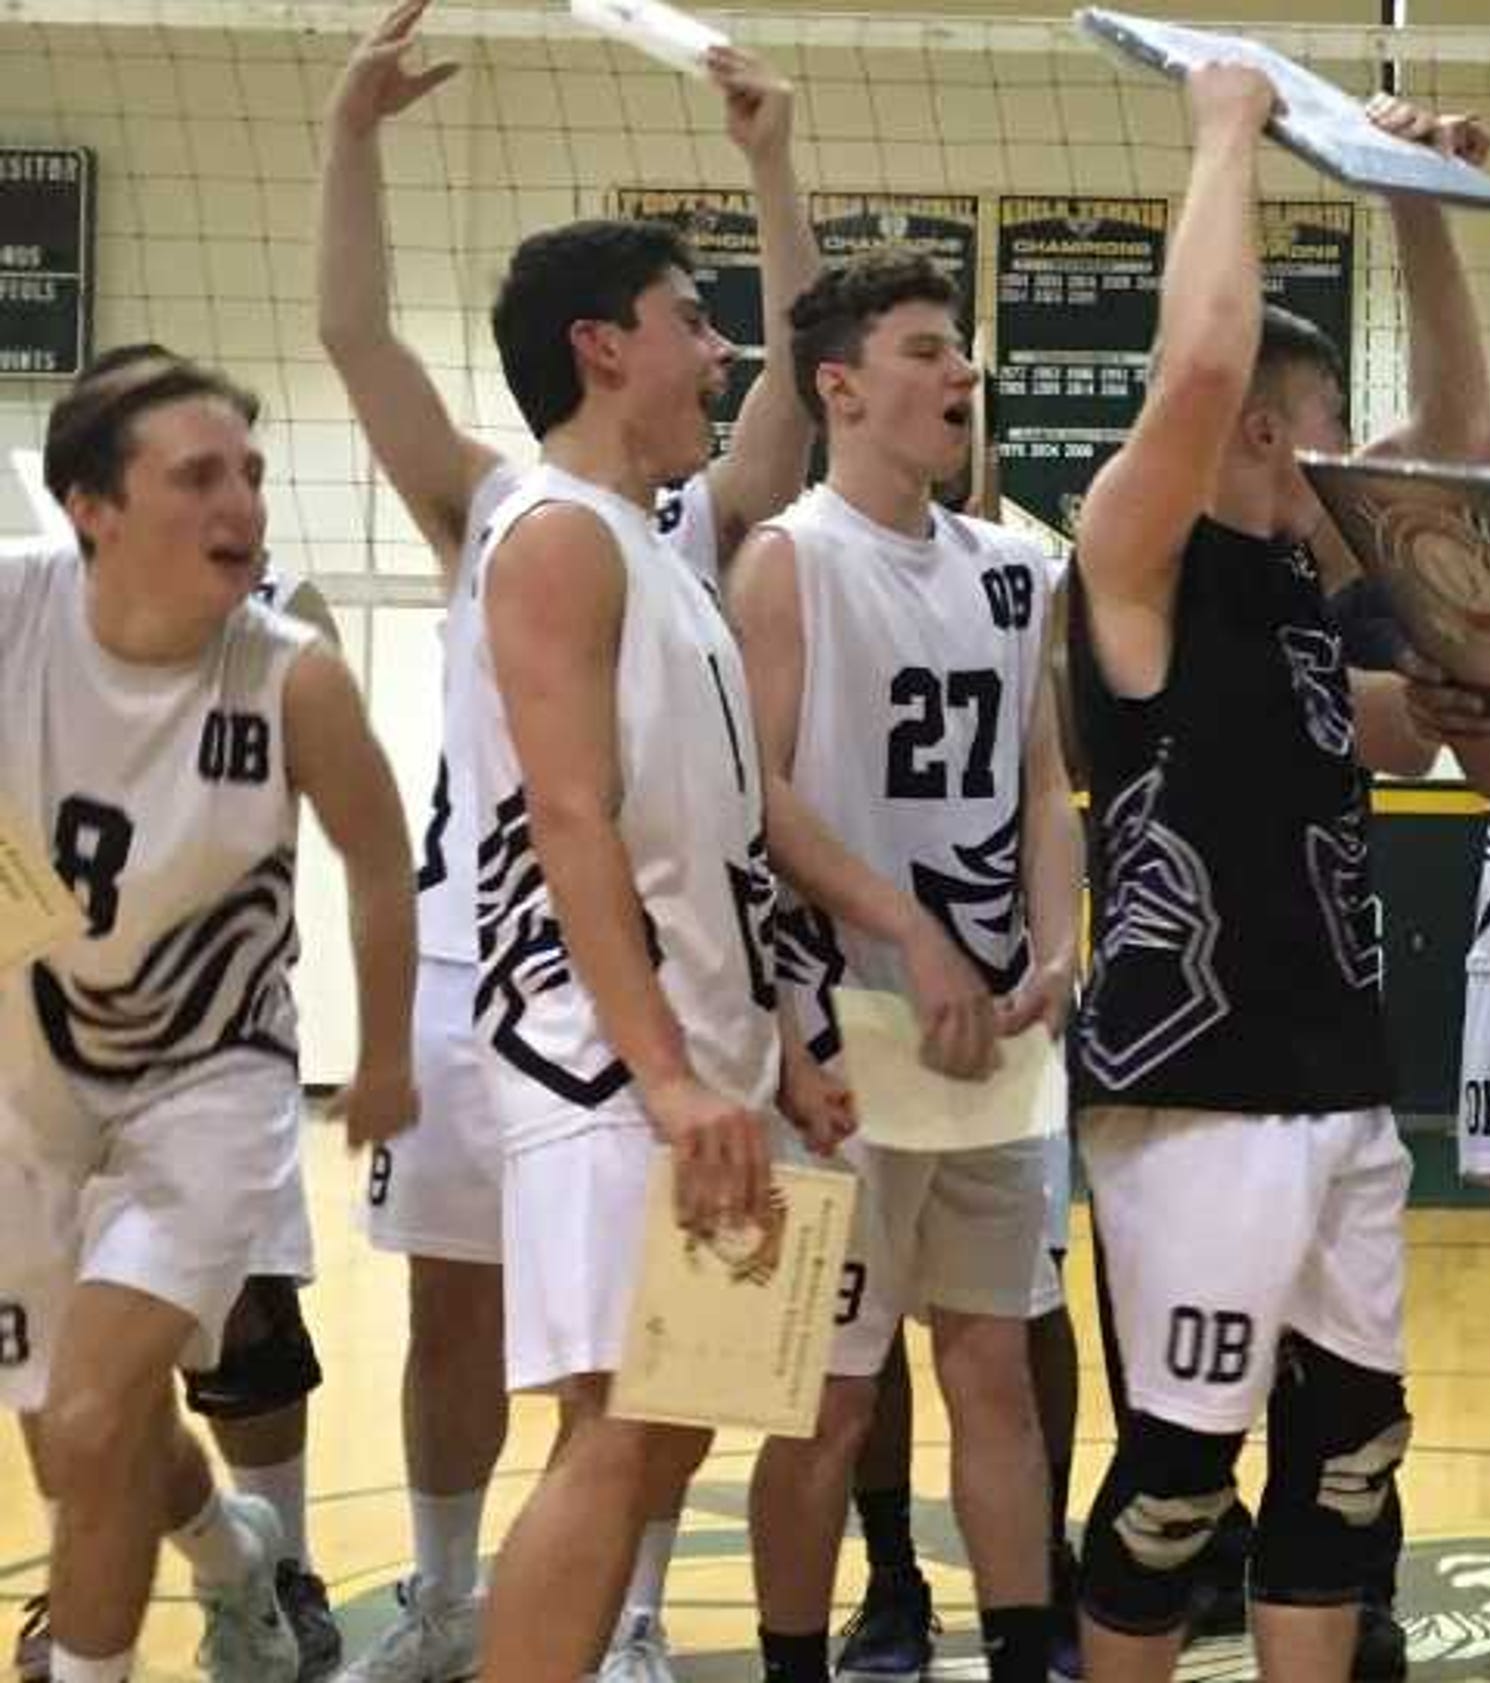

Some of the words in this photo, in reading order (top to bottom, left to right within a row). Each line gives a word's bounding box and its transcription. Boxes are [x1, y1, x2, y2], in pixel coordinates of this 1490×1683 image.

[981, 564, 1032, 630] OB
[199, 709, 270, 784] OB
[886, 667, 1003, 798] 27
[1168, 1307, 1252, 1383] OB
